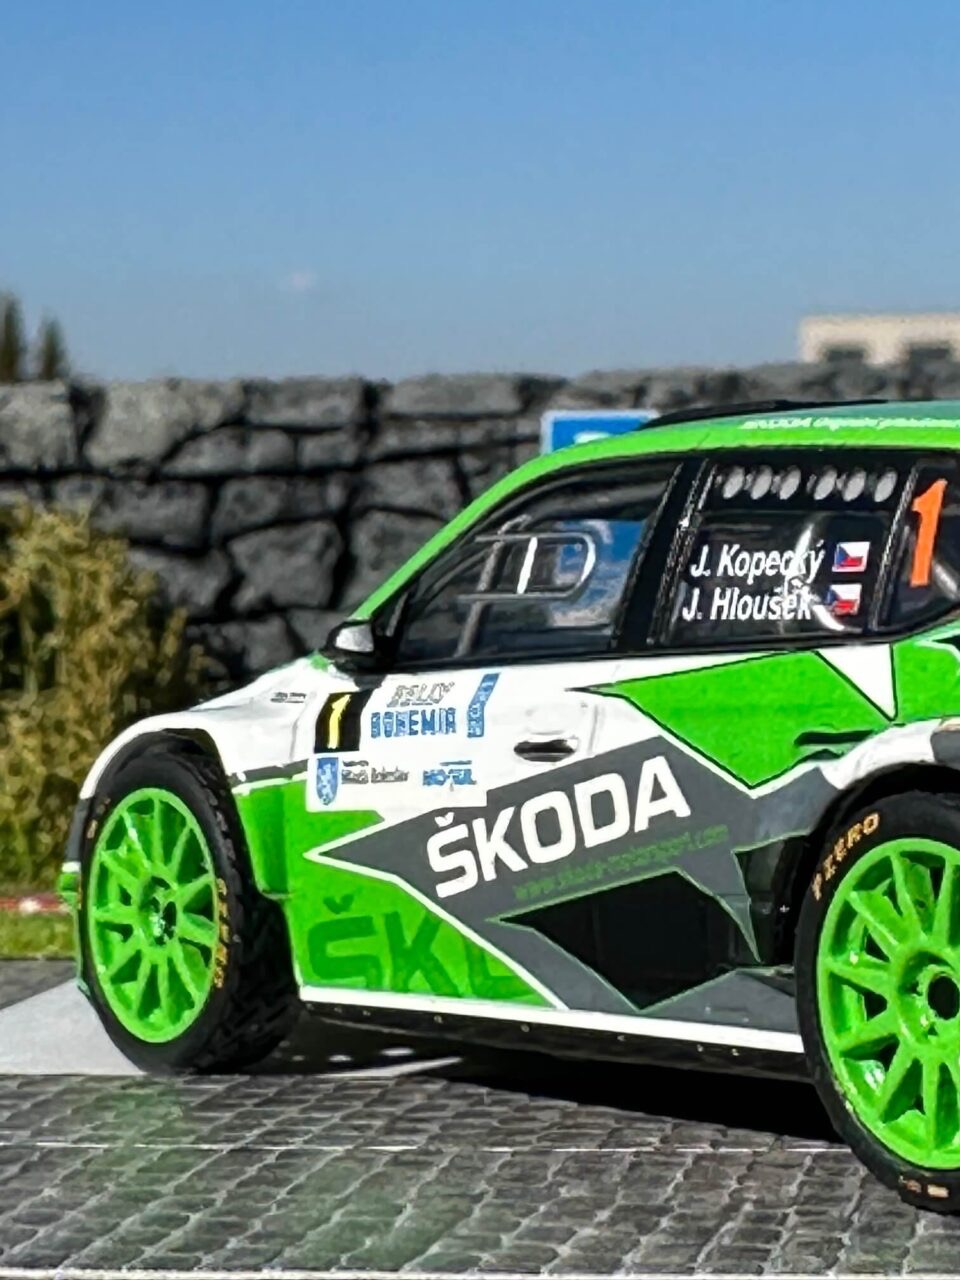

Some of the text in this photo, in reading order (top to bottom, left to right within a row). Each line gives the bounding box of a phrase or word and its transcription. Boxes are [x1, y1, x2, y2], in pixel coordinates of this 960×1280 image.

[911, 478, 948, 587] 1
[690, 540, 824, 585] J. Kopecký
[682, 581, 813, 621] J. Hloušek
[328, 694, 351, 750] 1
[426, 755, 691, 898] ŠKODA
